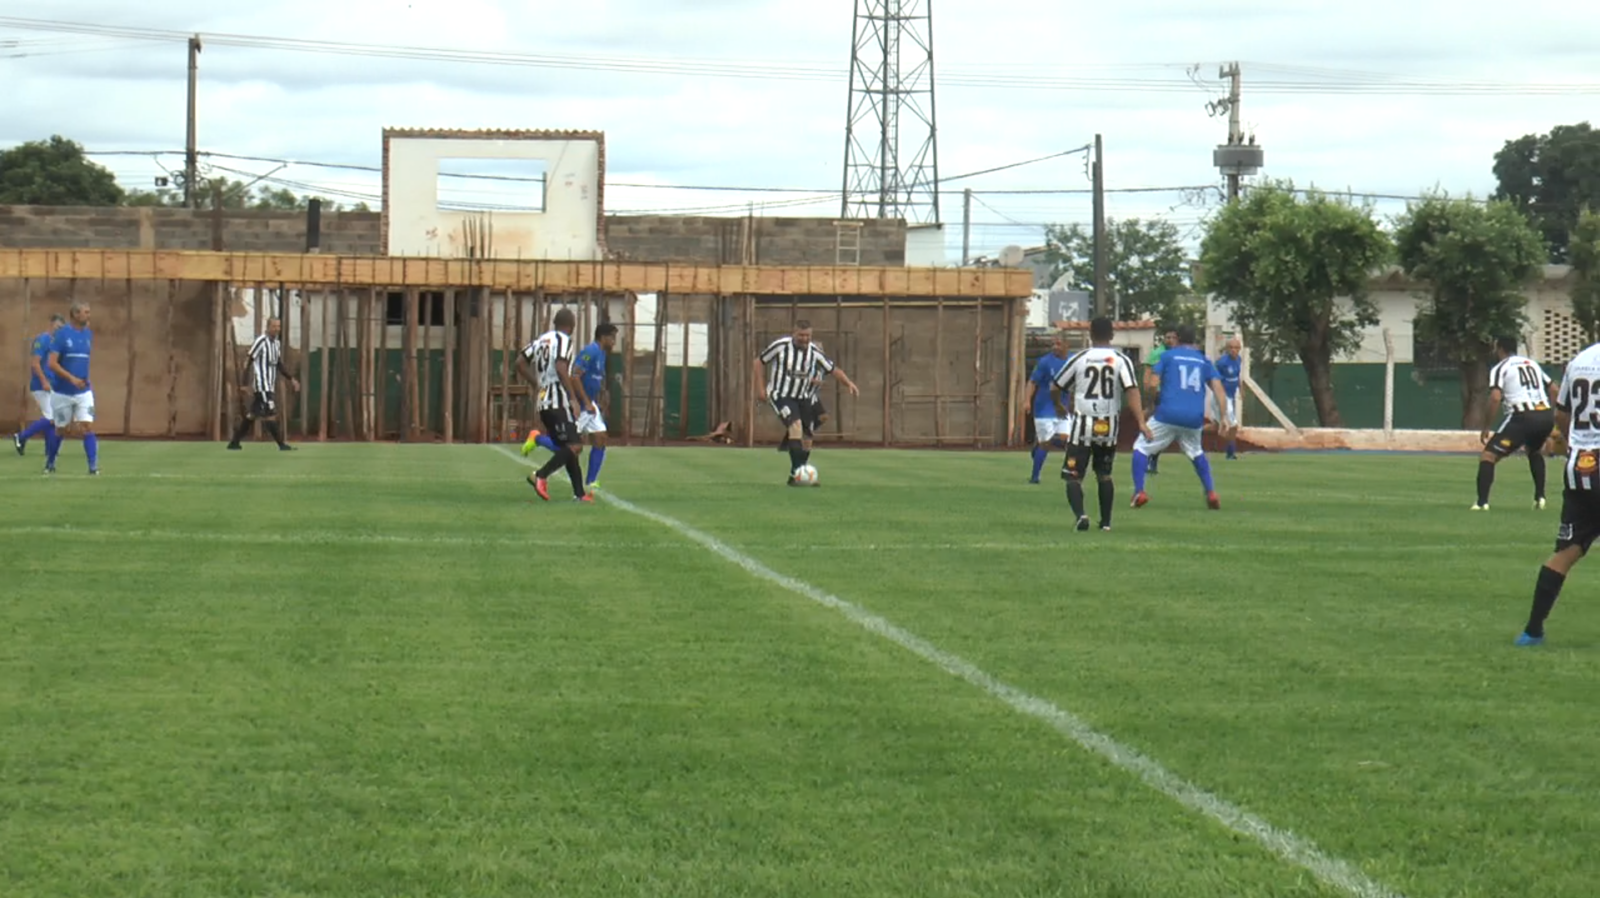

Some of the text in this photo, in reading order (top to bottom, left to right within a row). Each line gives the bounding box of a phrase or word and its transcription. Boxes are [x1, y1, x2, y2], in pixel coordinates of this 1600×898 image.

[1084, 365, 1114, 399] 26
[1179, 364, 1201, 392] 14
[1517, 364, 1540, 390] 40
